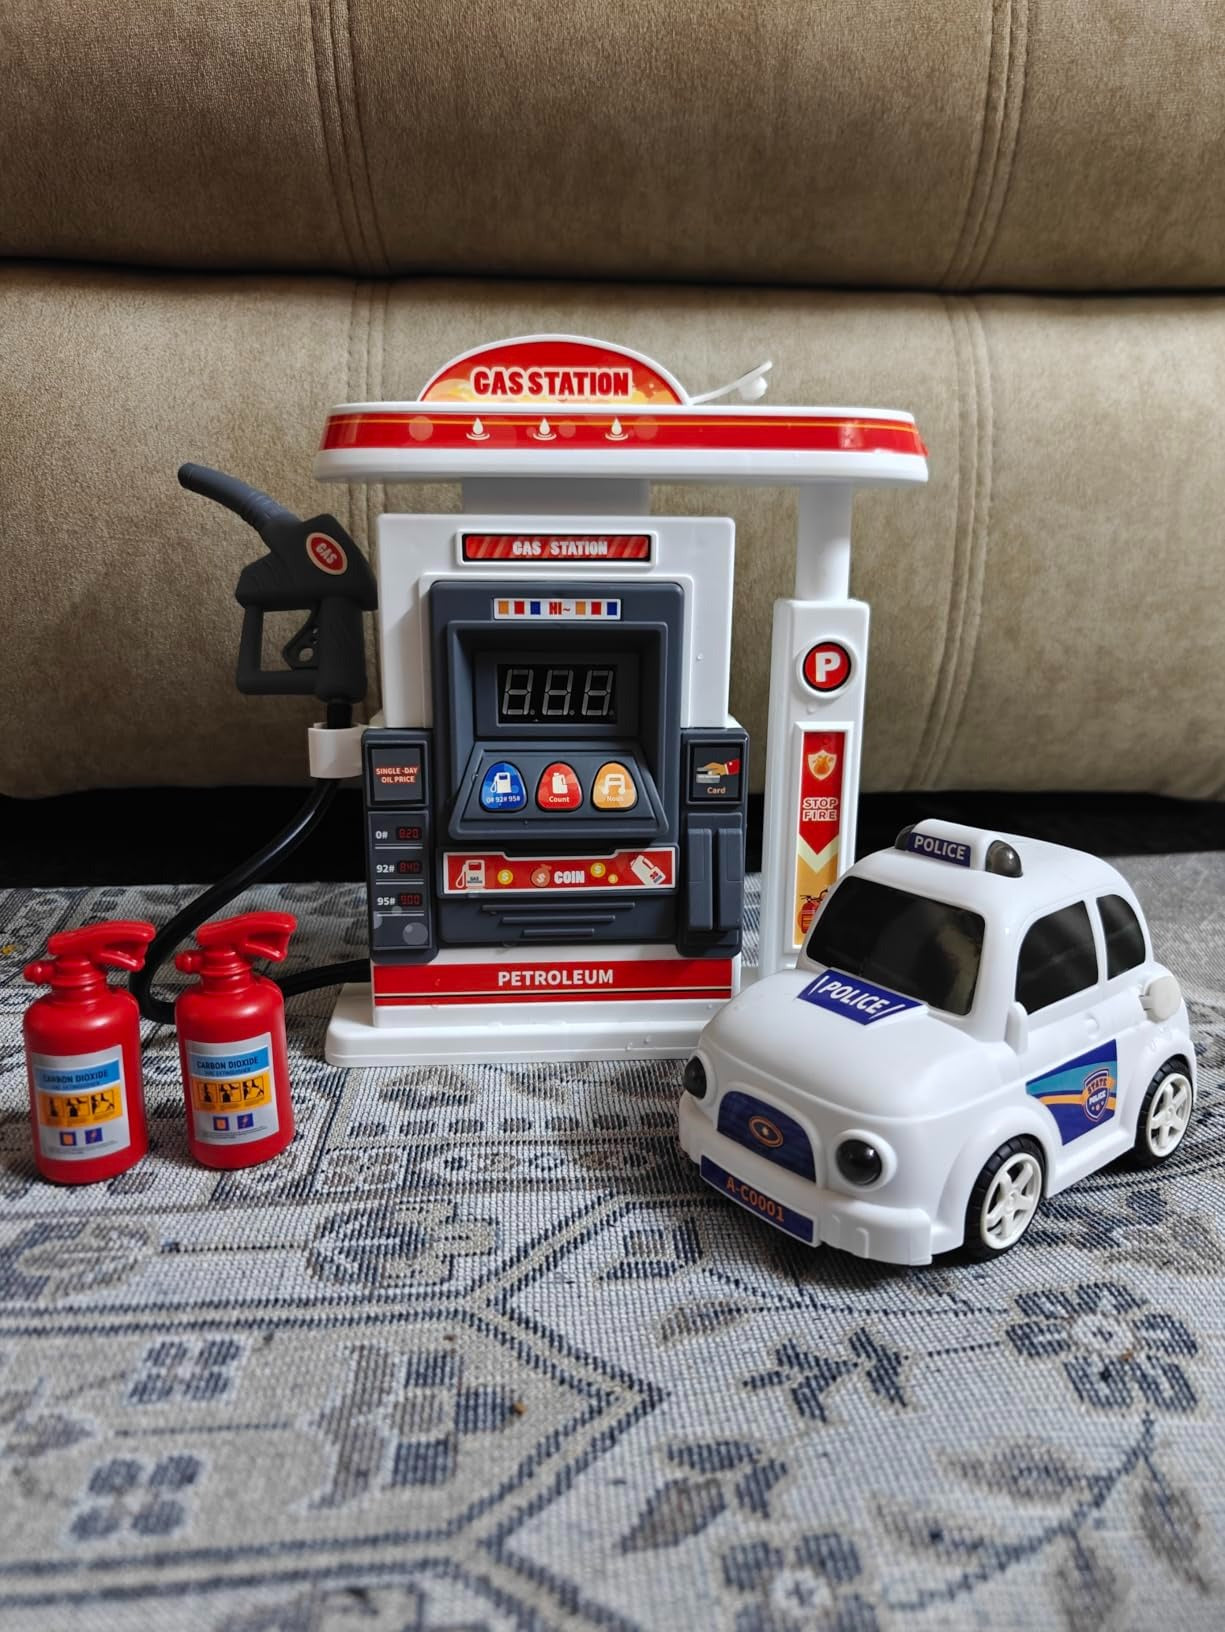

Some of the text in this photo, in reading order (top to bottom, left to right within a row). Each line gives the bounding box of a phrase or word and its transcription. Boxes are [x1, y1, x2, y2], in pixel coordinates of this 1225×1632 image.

[316, 543, 337, 564] GAS
[512, 541, 608, 555] GAS STATION
[815, 651, 841, 682] P
[394, 775, 415, 783] PRICE
[707, 786, 726, 794] Card
[803, 797, 838, 809] STOP
[803, 810, 837, 821] FIRE
[375, 831, 388, 840] 0#
[914, 835, 967, 860] POLICE
[376, 864, 395, 873] 92#
[554, 870, 585, 884] COIN
[377, 897, 396, 906] 95#
[498, 969, 614, 986] PETROLEUM
[819, 980, 890, 1015] POLICE
[196, 1056, 258, 1070] CARBON DIOXIDE
[75, 1069, 109, 1082] DIOXIDE
[1087, 1078, 1107, 1094] STATE
[726, 1174, 785, 1223] A-C0001
